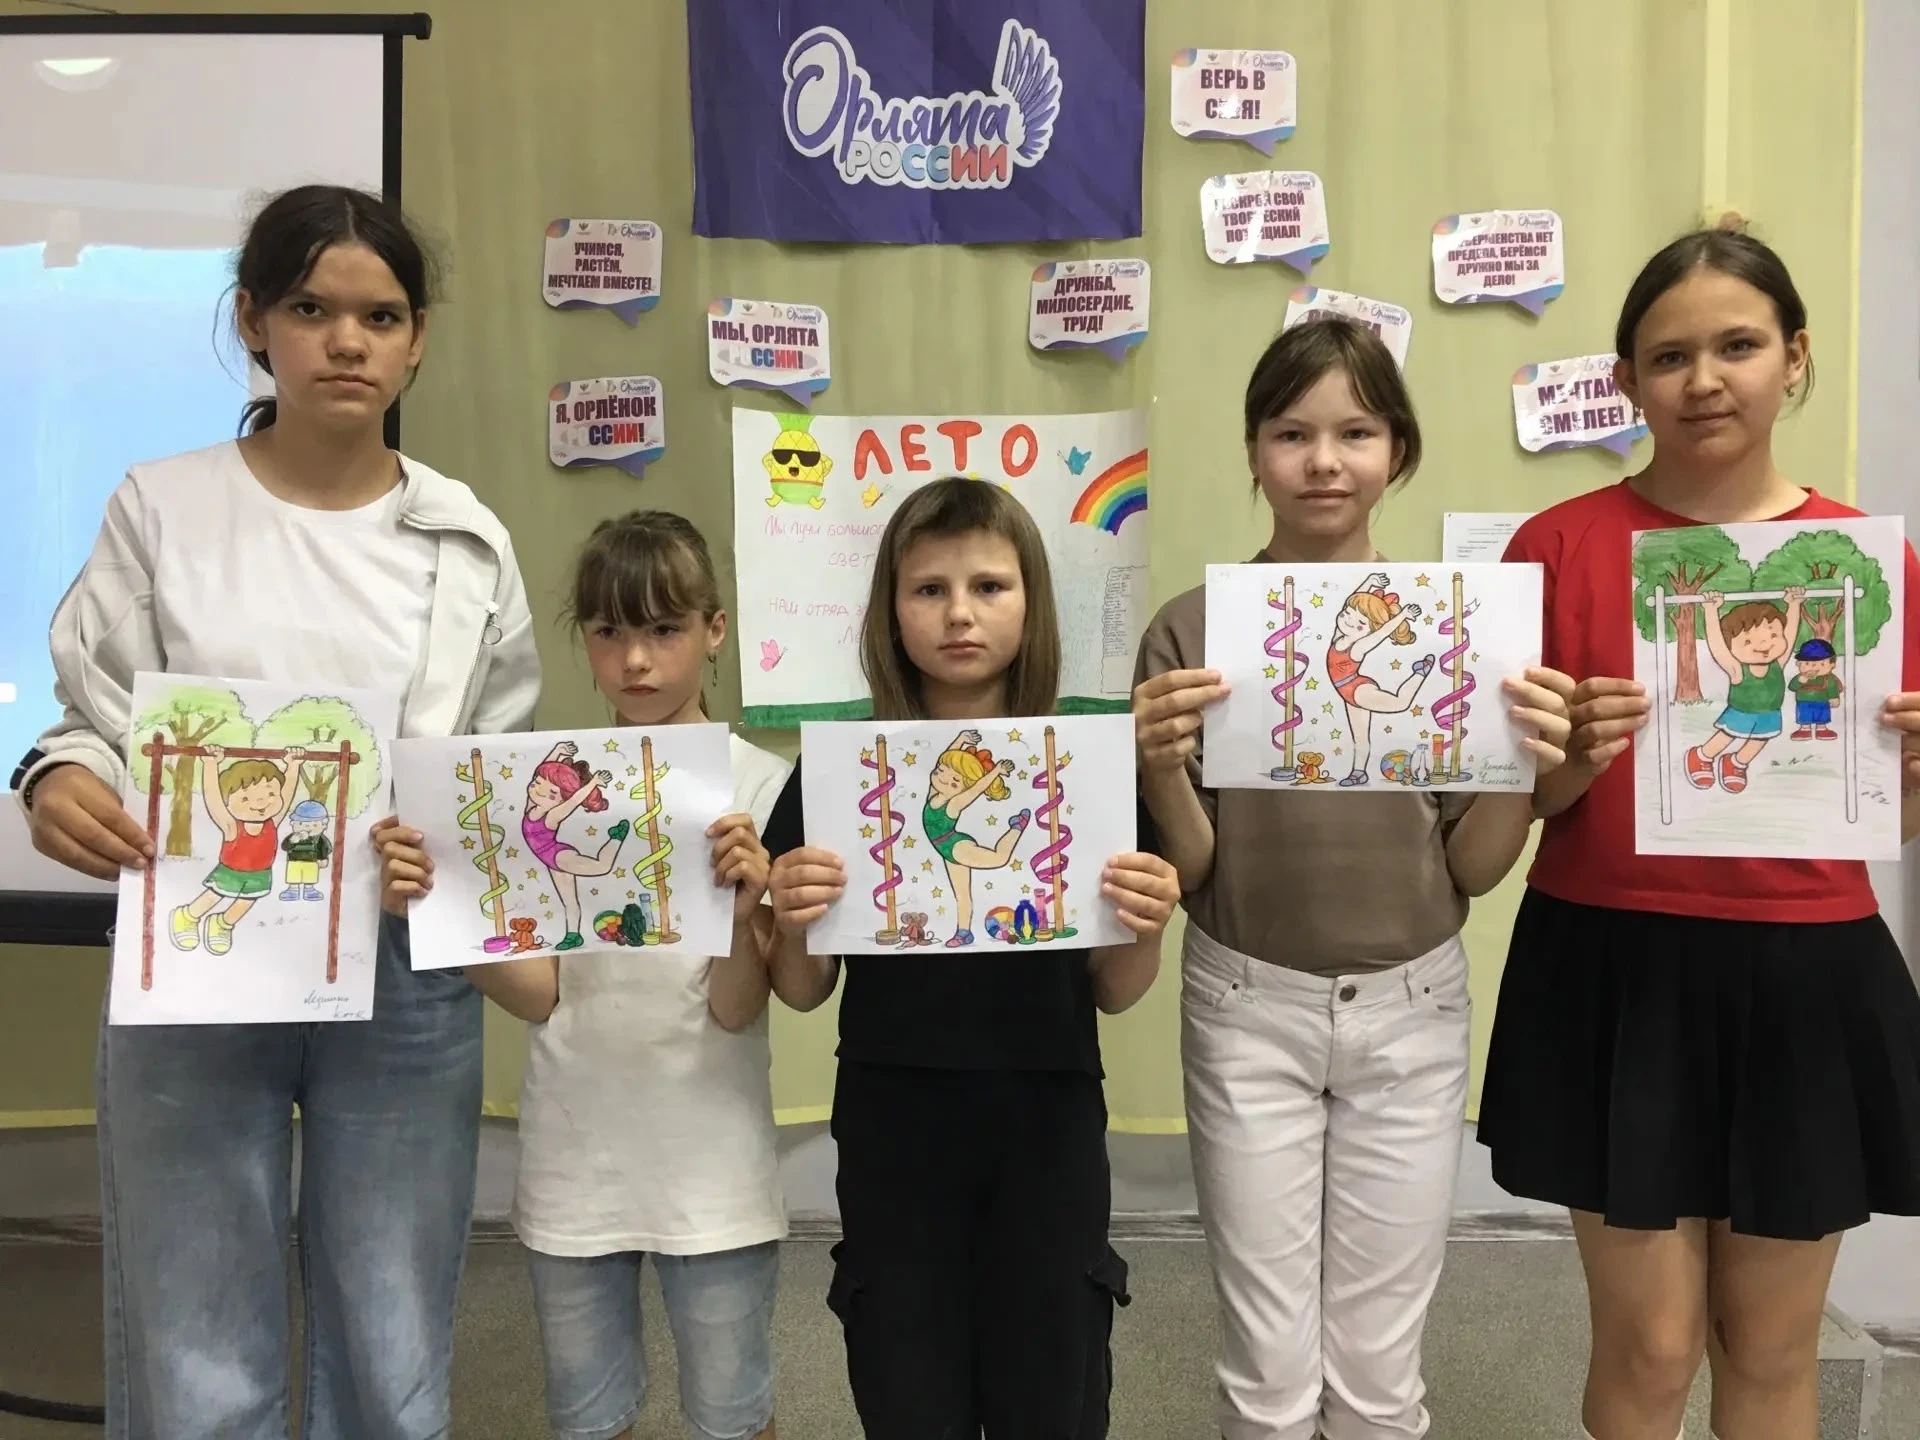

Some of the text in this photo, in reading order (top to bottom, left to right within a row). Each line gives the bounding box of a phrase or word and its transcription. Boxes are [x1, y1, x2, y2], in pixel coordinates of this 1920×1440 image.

[1201, 68, 1266, 90] ВЕРЬ В
[788, 33, 1010, 164] Орлята
[1205, 98, 1260, 119] СЯ!
[846, 141, 1007, 183] РОССИИ
[1274, 190, 1305, 205] СВОЙ
[1223, 207, 1300, 226] ТВОРЕСКИЙ
[1226, 225, 1301, 243] ПОТЦИАЛ!
[1536, 231, 1553, 242] НЕТ
[574, 242, 624, 257] УЧИМСЯ,
[1500, 245, 1547, 257] БЕРЁМСЯ
[575, 257, 622, 273] РАСТЁМ,
[1457, 260, 1539, 276] ДРУЖНО МЫ ЗА
[548, 274, 652, 290] МЕЧТАЕМ ВМЕСТЕ!
[1054, 275, 1116, 296] ДРУЖБА,
[1484, 274, 1516, 288] ДЕЛО!
[1036, 295, 1134, 315] МИЛОСЕРДИЕ,
[1063, 315, 1104, 333] ТРУД!
[712, 320, 819, 347] МЫ, ОРЛЯТА
[556, 395, 657, 424] Я, ОРЛЁНОК
[854, 420, 1038, 480] ЛЕТО
